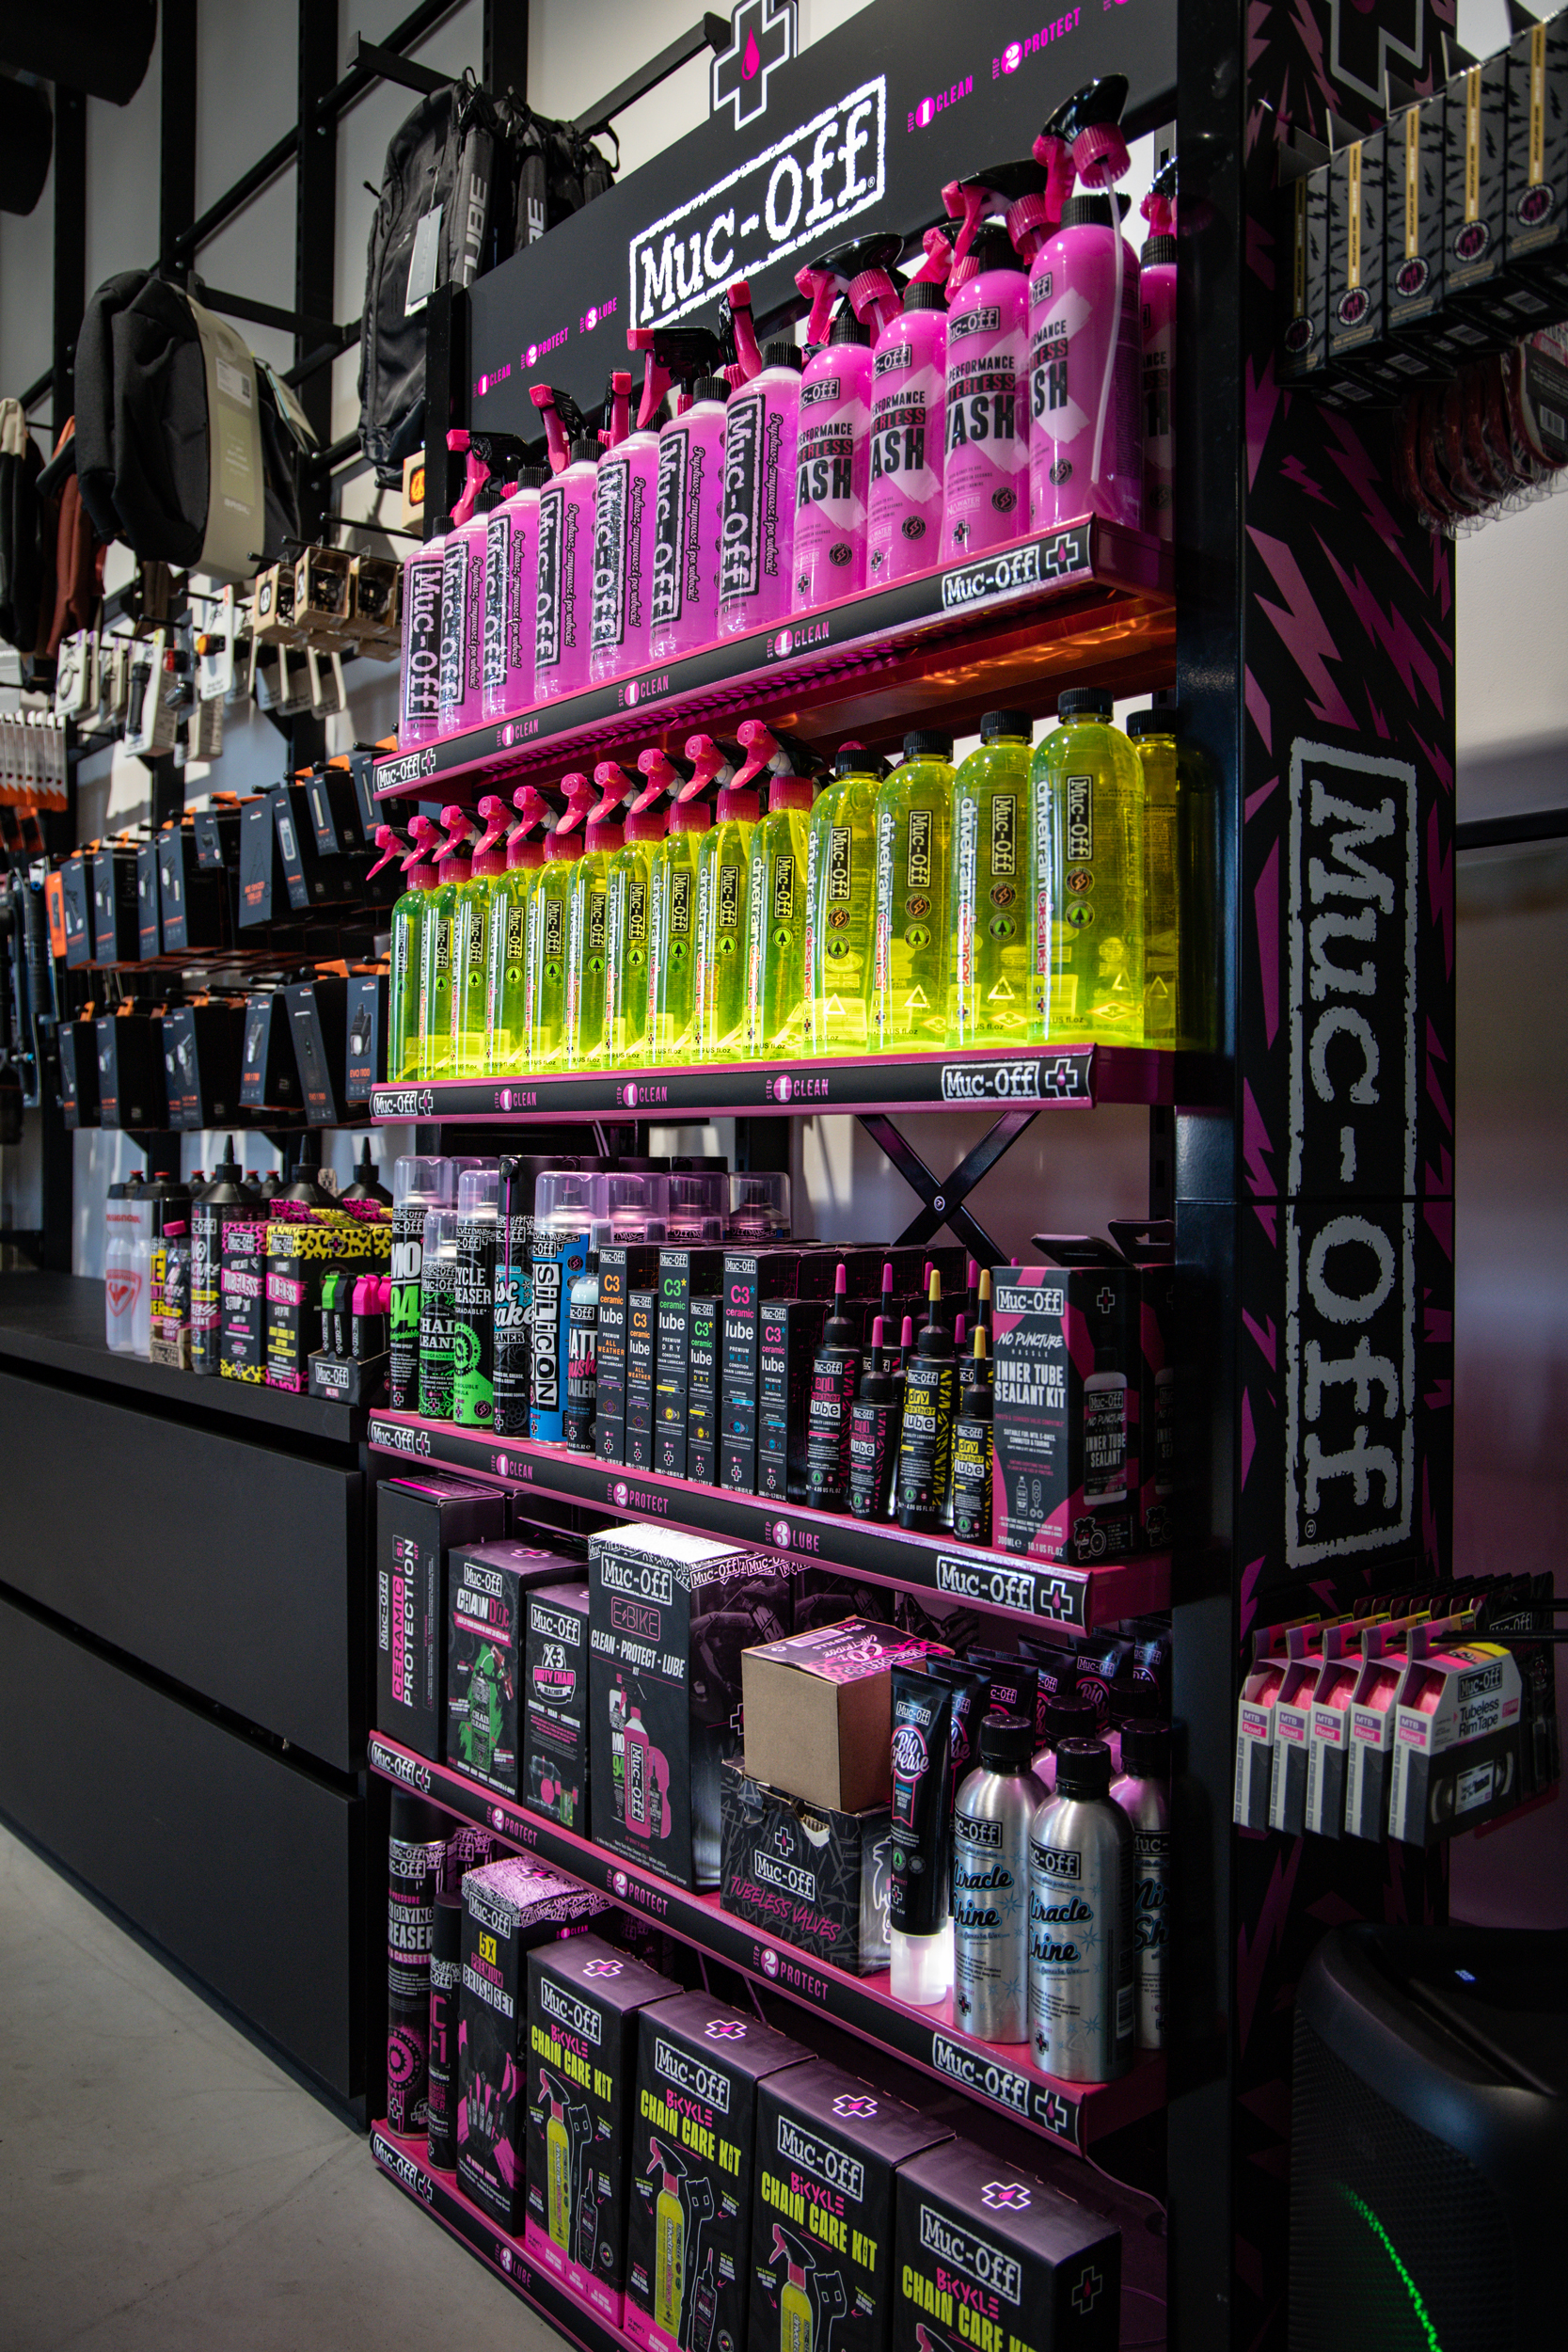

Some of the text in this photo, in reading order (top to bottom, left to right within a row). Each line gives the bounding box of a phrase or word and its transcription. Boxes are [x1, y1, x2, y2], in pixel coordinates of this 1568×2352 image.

[1024, 7, 1081, 57] PROTECT
[936, 75, 973, 112] CLEAN
[640, 100, 876, 327] Muc-Off
[464, 173, 487, 288] UBE
[721, 407, 752, 591] Muc-Off
[945, 550, 1036, 605] Muc-Off
[794, 621, 830, 648] CLEAN
[641, 675, 670, 699] CLEAN
[378, 760, 418, 788] Muc-Off
[879, 812, 895, 914] drivetrain
[958, 797, 978, 905] drivetrain
[806, 831, 819, 929] drivetrain
[1037, 780, 1053, 977] drivetrain cleaner
[751, 857, 766, 943] drivetrain
[639, 1086, 668, 1104] CLEAN
[794, 1078, 829, 1097] CLEAN
[945, 1066, 1036, 1097] Muc-Off
[375, 1093, 416, 1116] Muc-Off
[1306, 777, 1399, 1515] Muc-Off
[600, 1295, 624, 1305] ceramic
[660, 1300, 686, 1310] ceramic
[726, 1309, 754, 1318] ceramic
[999, 1290, 1061, 1312] Muc-Off
[600, 1307, 624, 1326] lube
[659, 1312, 686, 1331] lube
[725, 1320, 753, 1340] lube
[535, 1264, 559, 1405] SILICON
[998, 1331, 1063, 1349] NO PUNCTURE
[597, 1344, 625, 1356] WEATHER
[762, 1345, 784, 1355] ceramic
[762, 1356, 784, 1373] lube
[997, 1360, 1063, 1387] INNER TUBE
[811, 1400, 841, 1418] lube
[909, 1389, 929, 1405] dry
[994, 1381, 1066, 1408] SEALANT KIT
[903, 1413, 936, 1433] lube
[629, 1490, 669, 1514] PROTECT
[792, 1529, 820, 1552] LUBE
[466, 1567, 501, 1596] Muc-Off
[604, 1558, 669, 1599] Muc-Off
[942, 1563, 1031, 1608] Muc-Off
[457, 1588, 489, 1620] CHAIN
[404, 1538, 414, 1708] PROTECTION
[533, 1609, 578, 1642] Muc-Off
[394, 1581, 403, 1697] CERAMIC
[545, 1646, 563, 1668] X-3
[591, 1629, 686, 1679] CLEAN PROTECT LUBE
[534, 1668, 575, 1685] DIRTY CHAIN
[898, 1704, 929, 1724] Muc-Off
[1243, 1711, 1259, 1724] MTB
[1280, 1713, 1297, 1725] MTB
[1317, 1714, 1334, 1725] MTB
[1355, 1715, 1373, 1727] MTB
[1401, 1717, 1419, 1729] MTB
[1460, 1699, 1499, 1722] Tubeless
[898, 1731, 918, 1755] Bio
[1243, 1724, 1261, 1735] Road
[1280, 1725, 1298, 1738] Road
[1316, 1726, 1335, 1739] Road
[1354, 1727, 1374, 1740] Road
[1400, 1730, 1420, 1743] Road
[373, 1747, 414, 1783] Muc-Off
[757, 1855, 813, 1900] Muc-Off
[628, 1883, 669, 1916] PROTECT
[731, 1876, 841, 1943] TUBELESS VALVES
[470, 1897, 509, 1935] Muc-Off
[471, 1952, 503, 1989] PREMIUM
[781, 1961, 829, 2001] PROTECT
[463, 1964, 493, 2005] BRUSH
[494, 1987, 514, 2018] SET
[544, 1988, 599, 2042] Muc-Off
[531, 2024, 612, 2103] CHAIN CARE KIT
[937, 2040, 1026, 2109] Muc-Off
[658, 2049, 728, 2109] Muc-Off
[641, 2090, 741, 2177] CHAIN CARE KIT
[376, 2136, 415, 2183] Muc-Off
[781, 2124, 861, 2198] Muc-Off
[761, 2171, 878, 2272] CHAIN CARE KIT
[925, 2214, 1019, 2298] Muc-Off
[902, 2265, 1004, 2352] CHAIN CARE
